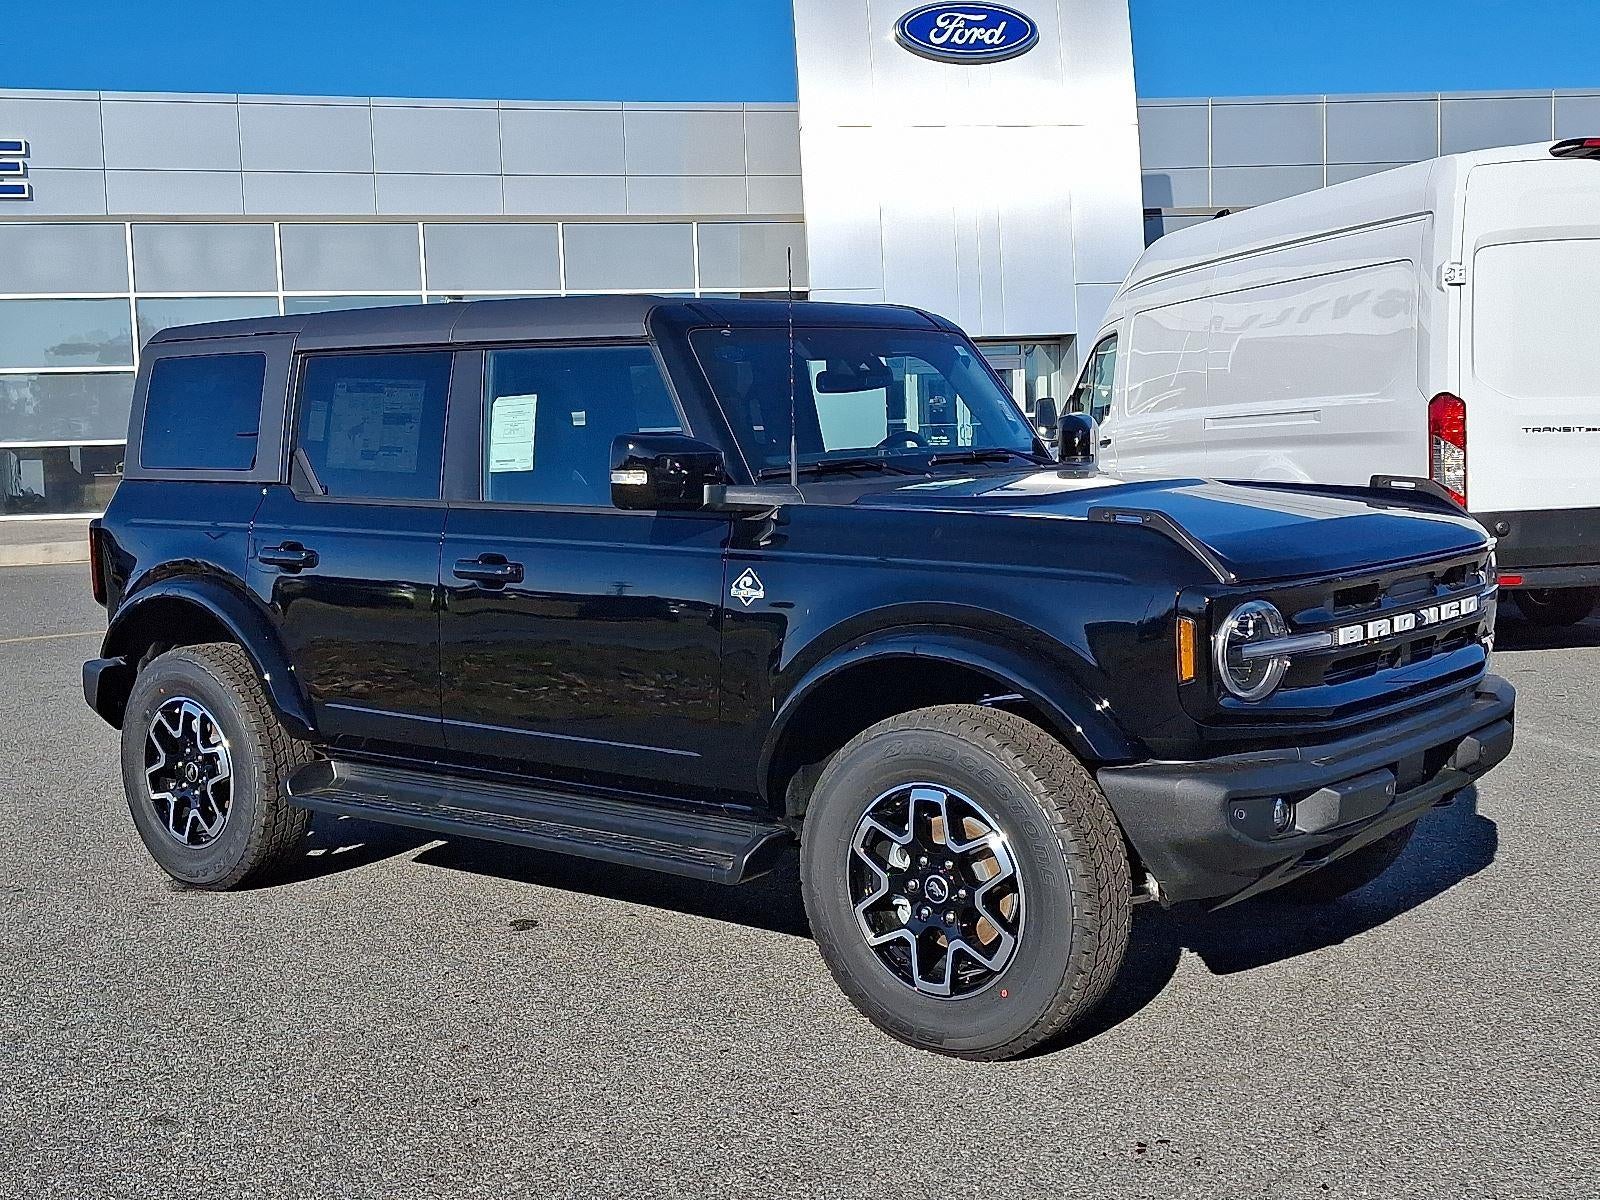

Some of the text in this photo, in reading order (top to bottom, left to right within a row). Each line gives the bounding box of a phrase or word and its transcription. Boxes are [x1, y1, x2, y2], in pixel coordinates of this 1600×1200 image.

[929, 12, 1007, 45] Ford
[1338, 595, 1478, 646] BRONCO
[881, 736, 1059, 888] BRIDGESTONE
